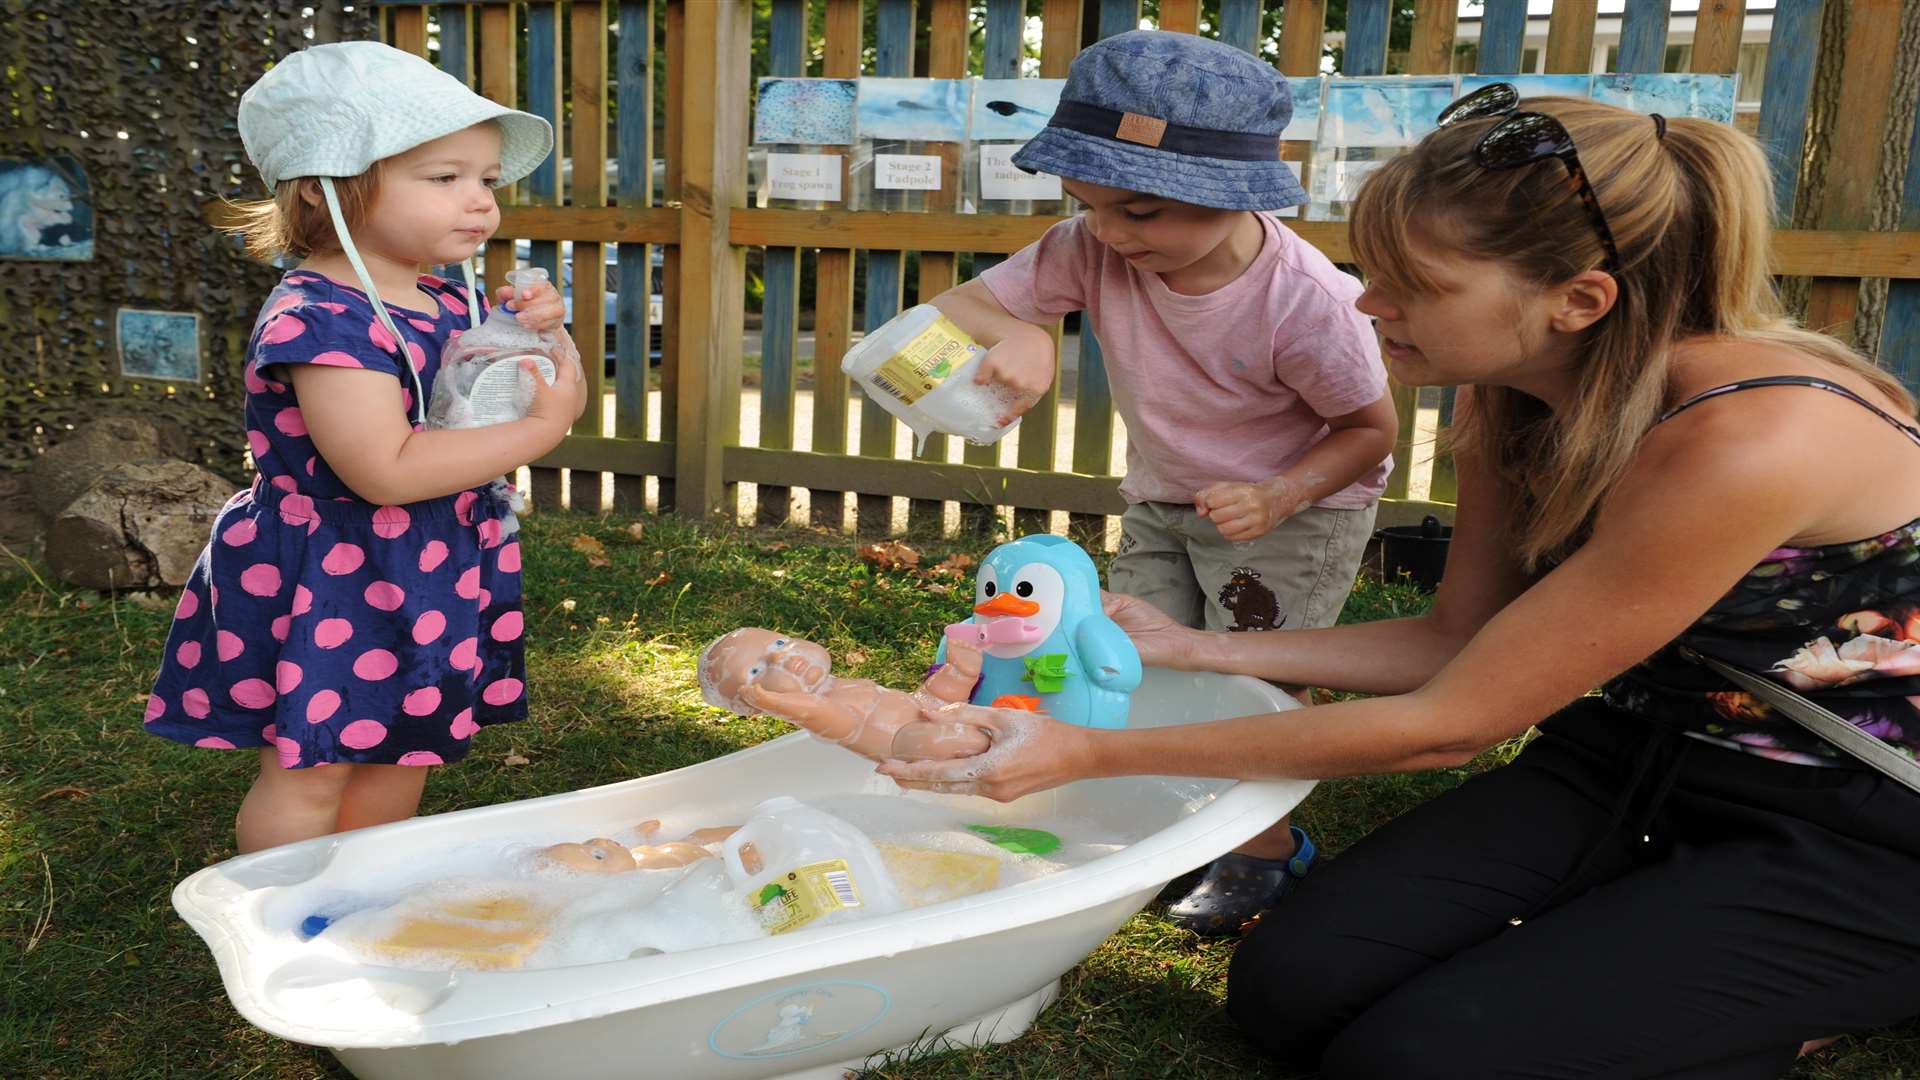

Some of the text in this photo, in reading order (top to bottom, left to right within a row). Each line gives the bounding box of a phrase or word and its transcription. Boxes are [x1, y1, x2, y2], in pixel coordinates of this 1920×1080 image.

[887, 161, 932, 172] Stage 2
[984, 157, 1009, 167] The
[782, 168, 812, 178] Stage
[885, 174, 936, 186] Tadpole
[798, 182, 833, 192] spawn
[780, 889, 799, 905] LIFE
